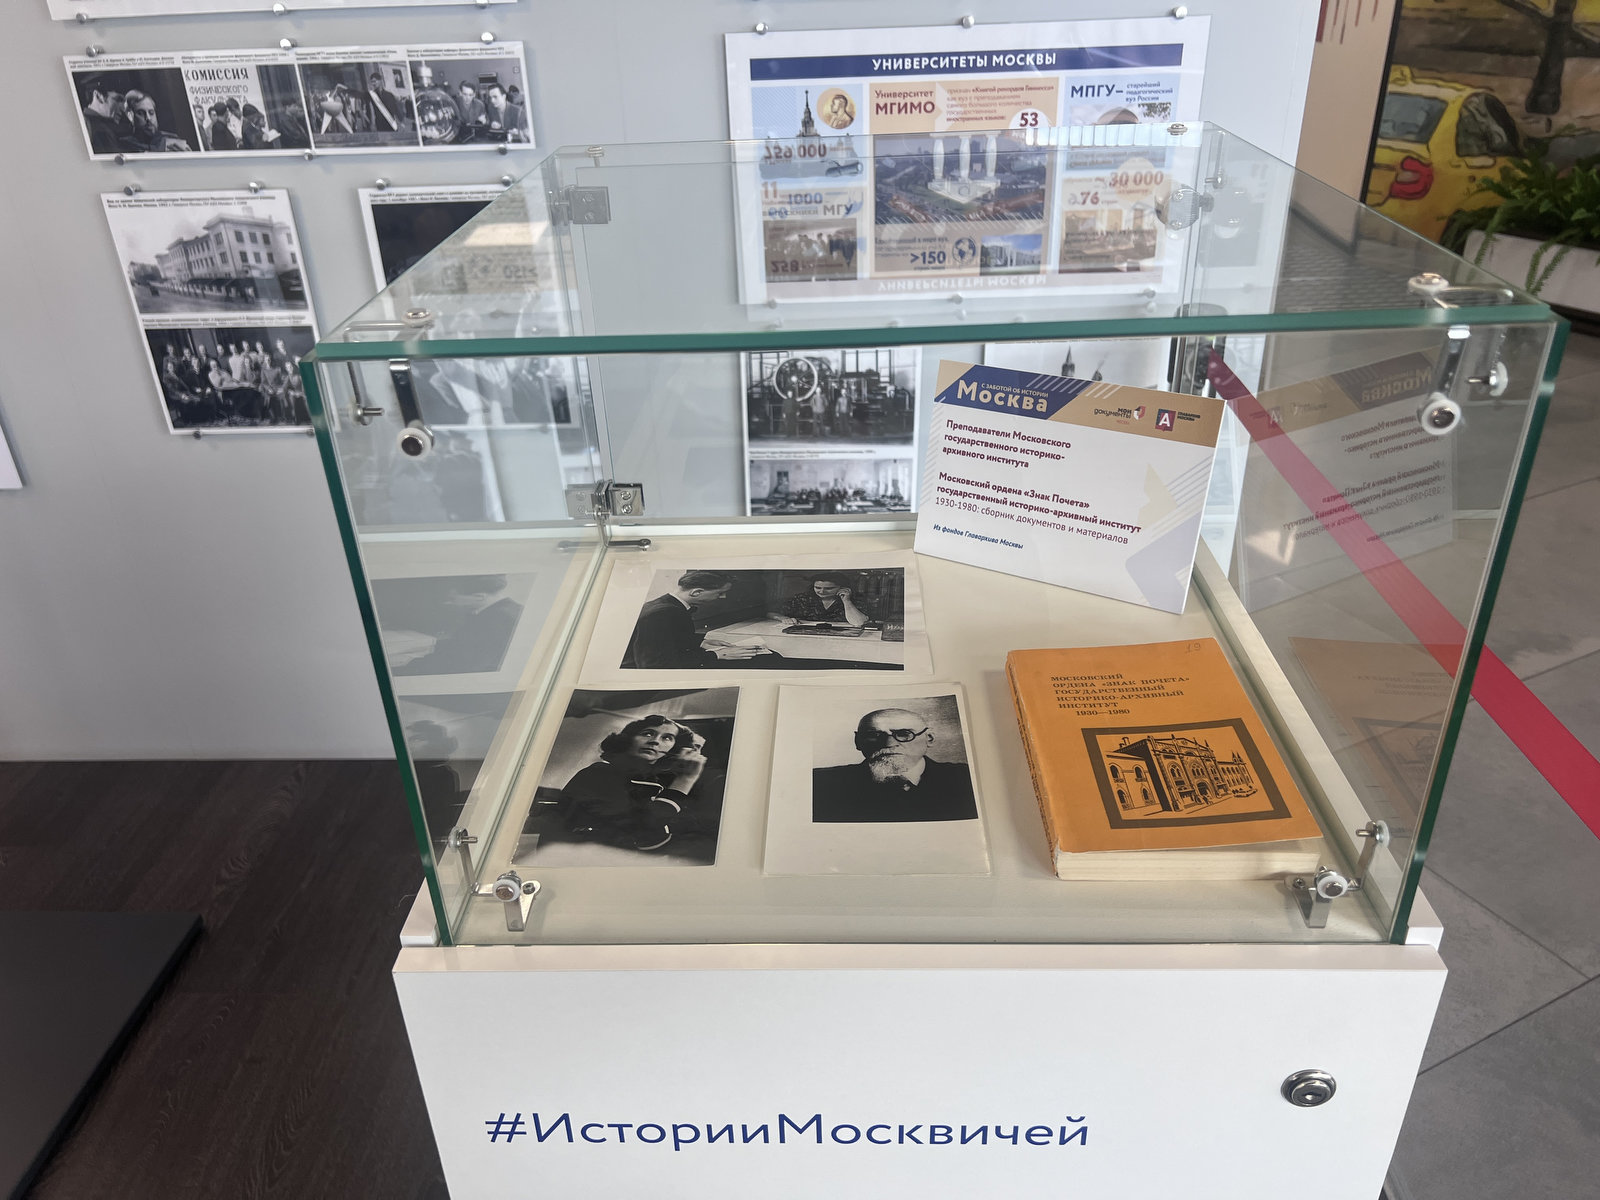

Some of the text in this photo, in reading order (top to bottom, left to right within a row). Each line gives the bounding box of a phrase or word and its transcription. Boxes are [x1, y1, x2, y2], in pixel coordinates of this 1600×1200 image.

[872, 53, 1057, 71] УНИВЕРСИТЕТЫ МОСКВЫ
[184, 68, 249, 81] КОМИССИЯ
[189, 85, 249, 94] ФИЗИЧЕСКОГО
[875, 90, 934, 100] Университет
[875, 101, 935, 115] МГИМО
[1019, 112, 1038, 127] 53
[823, 203, 853, 216] МГУ
[910, 250, 946, 265] >150
[957, 379, 1048, 413] Москва
[986, 383, 1012, 393] ЗАБОТОЙ
[1021, 388, 1049, 398] ИСТОРИИ
[946, 420, 1071, 449] Преподаватели Московского
[944, 434, 1066, 461] государственного историко-
[942, 446, 1029, 468] архивного института
[939, 471, 1090, 509] Московский ордена «Знак Почета»
[936, 485, 1142, 534] государственный историко-архивный институт
[935, 496, 980, 514] 1930-1980:
[981, 507, 1015, 521] сборник
[1016, 515, 1066, 531] документов
[1075, 527, 1129, 545] материалов
[933, 523, 1024, 549] Из фондов Главархива Москвы
[1050, 673, 1123, 682] МОСКОВСКИЙ
[1141, 676, 1190, 685] ПОЧЕТА»
[1055, 684, 1165, 695] ГОСУДАРСТВЕННЫЙ
[1056, 690, 1185, 702] ИСТОРИКО-АРХИВНЫЙ
[1058, 701, 1119, 709] ИНСТИТУТ
[1076, 708, 1131, 716] 1930—1980
[484, 1112, 1090, 1152] #ИсторииМосквичей
